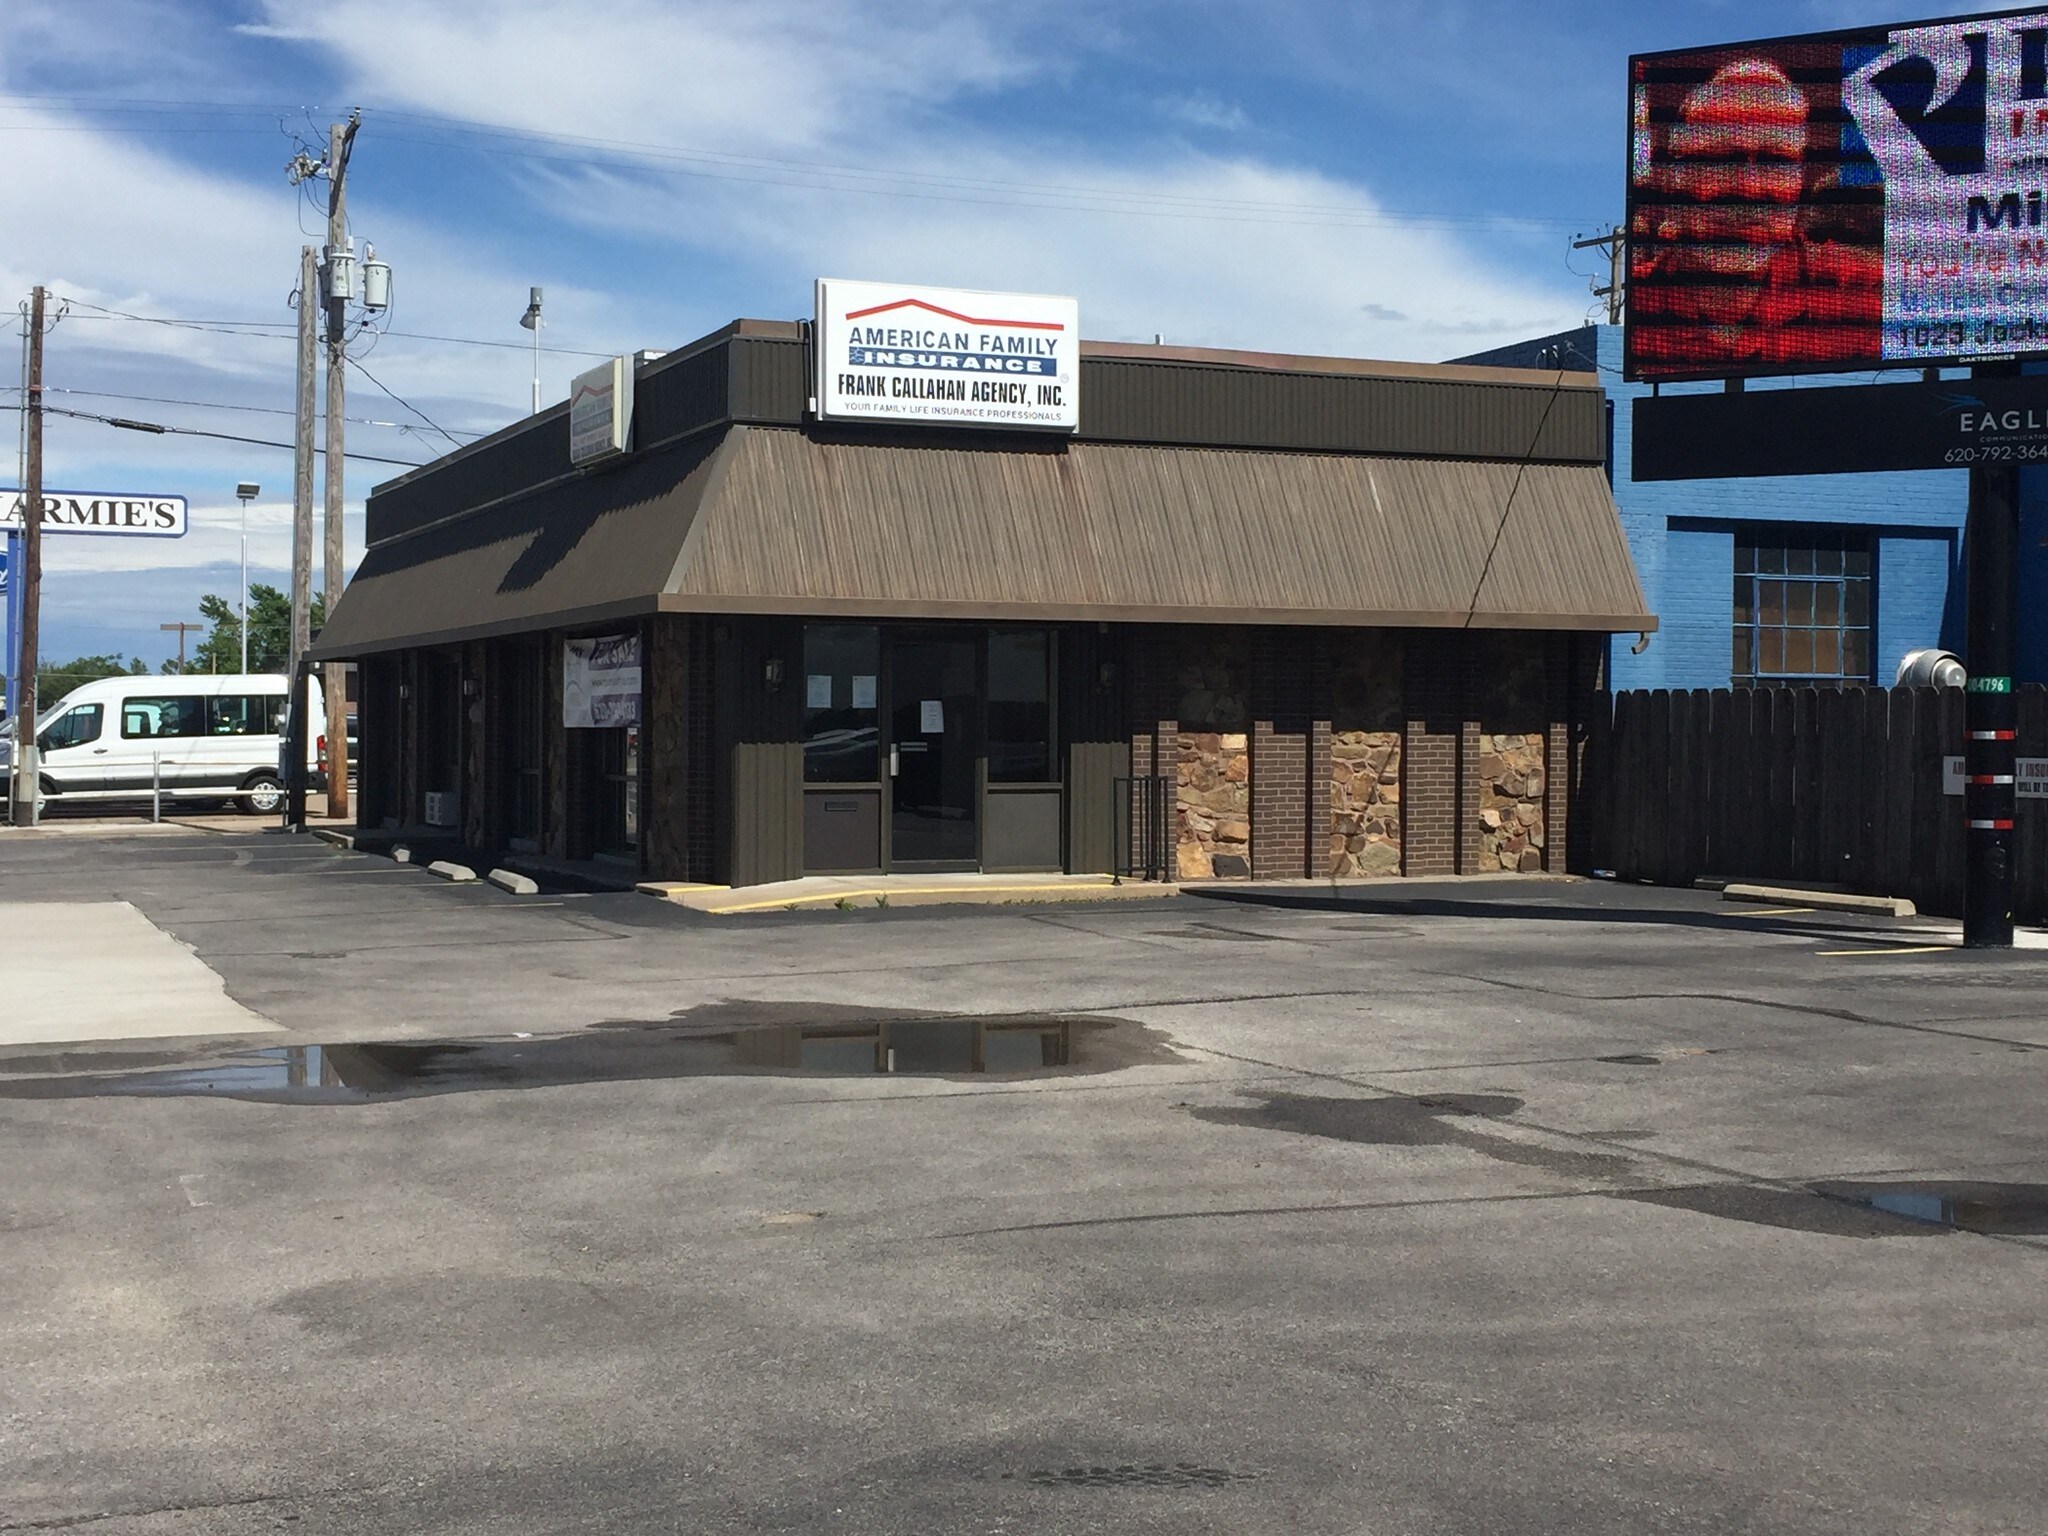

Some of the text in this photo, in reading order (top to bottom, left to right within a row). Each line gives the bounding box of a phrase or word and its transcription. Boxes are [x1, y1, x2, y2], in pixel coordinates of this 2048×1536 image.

[849, 326, 1058, 356] AMERICAN FAMILY
[863, 351, 1042, 373] INSURANCE
[838, 373, 1066, 408] FRANK CALLAHAN AGENCY, INC.
[845, 402, 1062, 421] YOUR FAMILY LIFE INSURANCE PROFESSIONALS
[1960, 409, 2048, 432] EAGL
[0, 496, 176, 528] ARMIE'S
